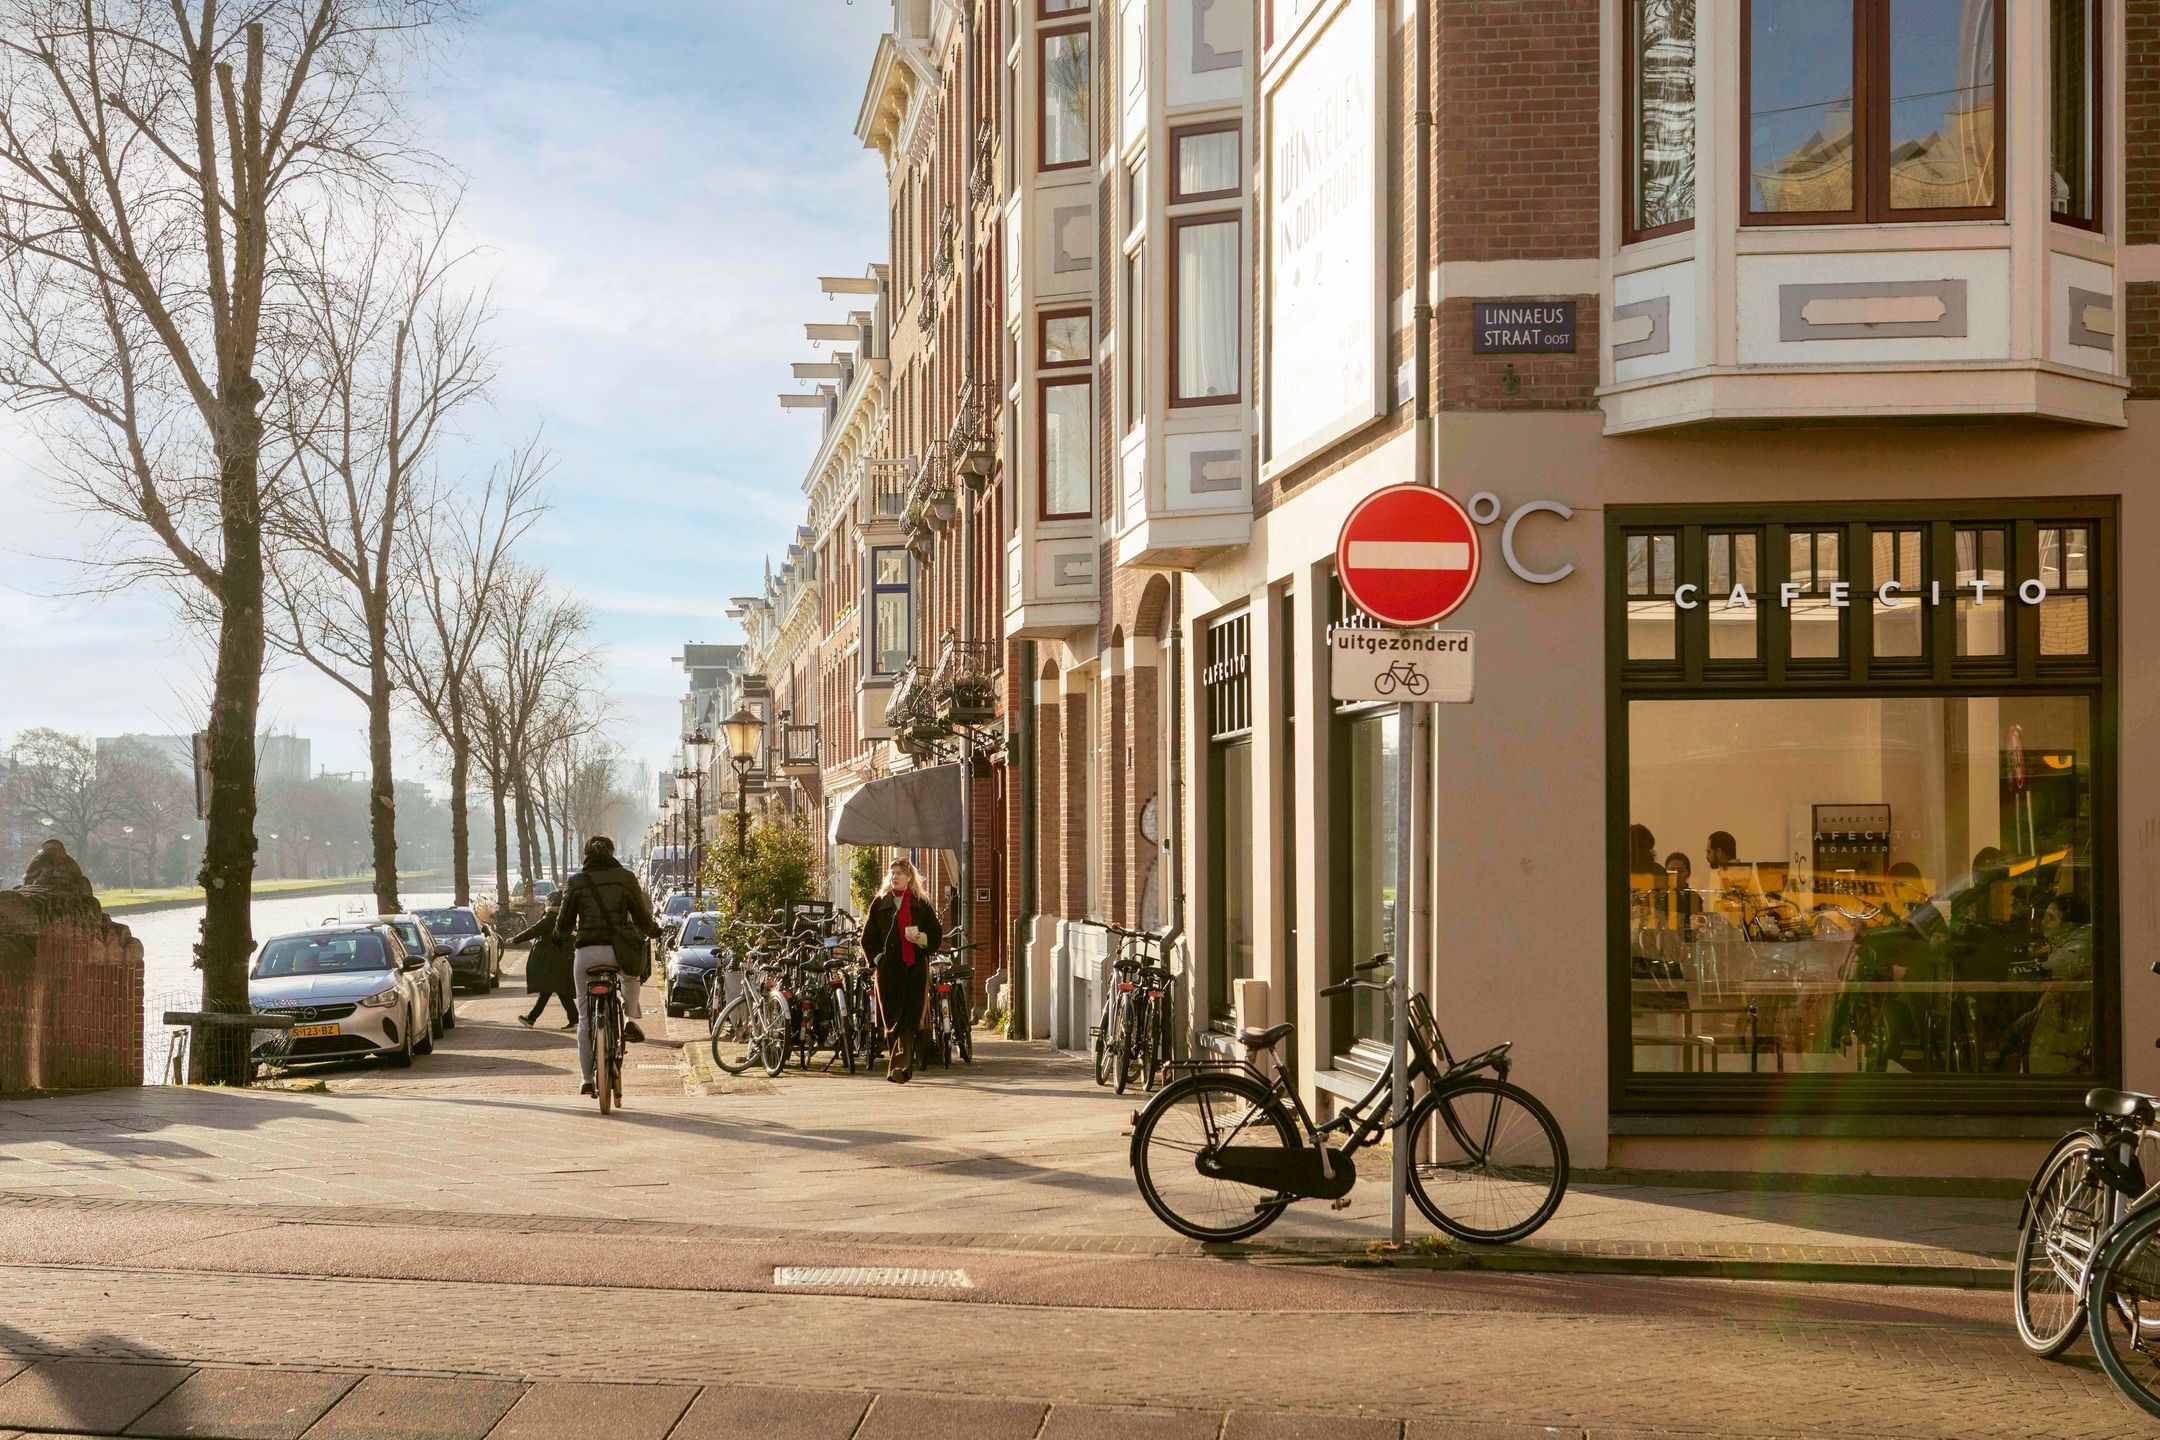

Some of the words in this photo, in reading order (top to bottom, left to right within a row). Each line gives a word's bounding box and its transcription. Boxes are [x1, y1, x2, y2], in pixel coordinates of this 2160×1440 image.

[1280, 73, 1367, 205] WINKELEN
[1296, 144, 1368, 251] OOSTPOORT
[1485, 308, 1564, 325] LINNAEUS
[1484, 329, 1542, 346] STRAAT
[1544, 333, 1570, 345] OOST
[1675, 579, 2047, 609] CAFECITO
[1338, 634, 1469, 654] uitgezonderd
[1203, 653, 1246, 687] CAFECITO
[1796, 830, 1921, 841] CAFECITO
